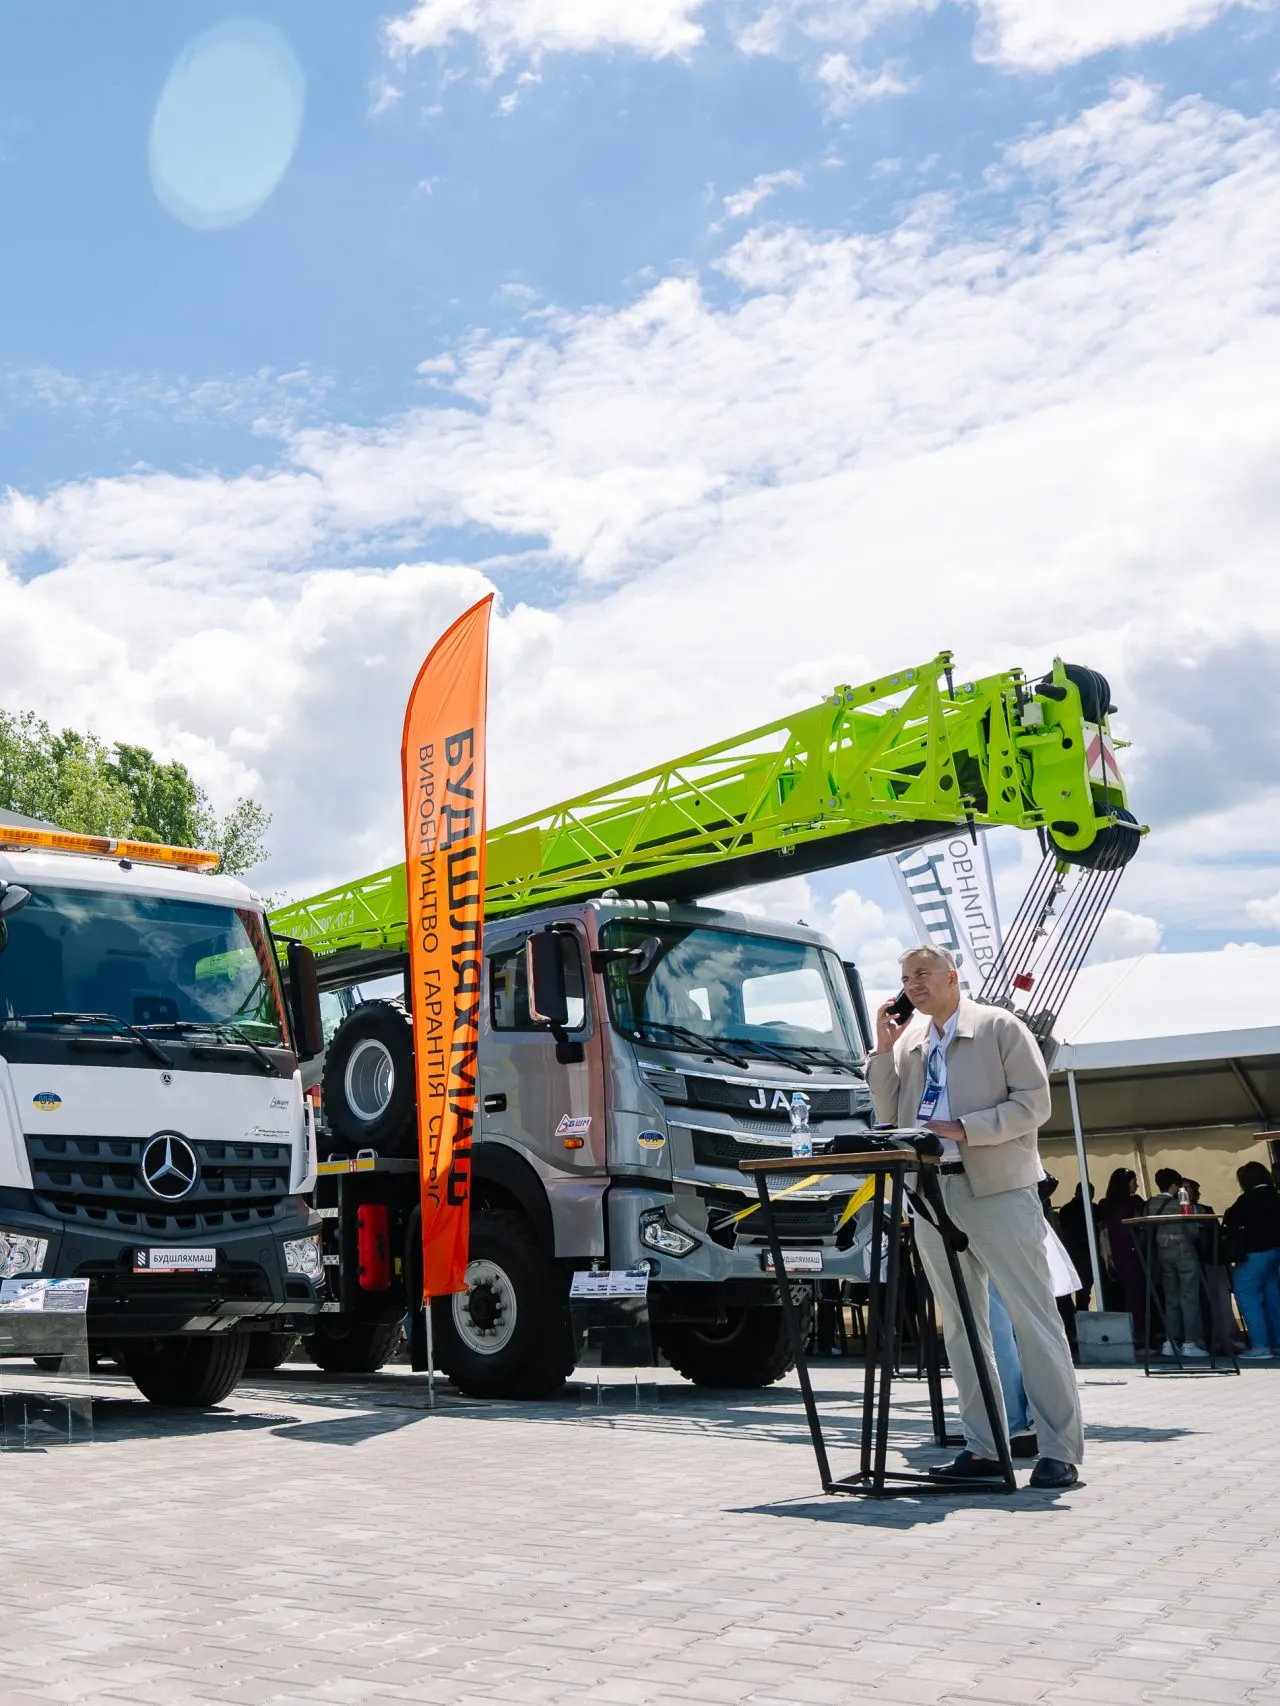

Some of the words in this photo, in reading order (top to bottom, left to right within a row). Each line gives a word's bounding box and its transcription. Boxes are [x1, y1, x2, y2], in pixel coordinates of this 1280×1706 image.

[419, 743, 439, 954] ВИРОБНИЦТВО
[440, 728, 481, 1206] БУДШЛЯХМАШ
[423, 969, 445, 1098] ГАРАНТІЯ
[153, 1254, 213, 1264] БУДШЛЯХМАШ
[783, 1256, 820, 1264] ДШЛЯХМАШ
